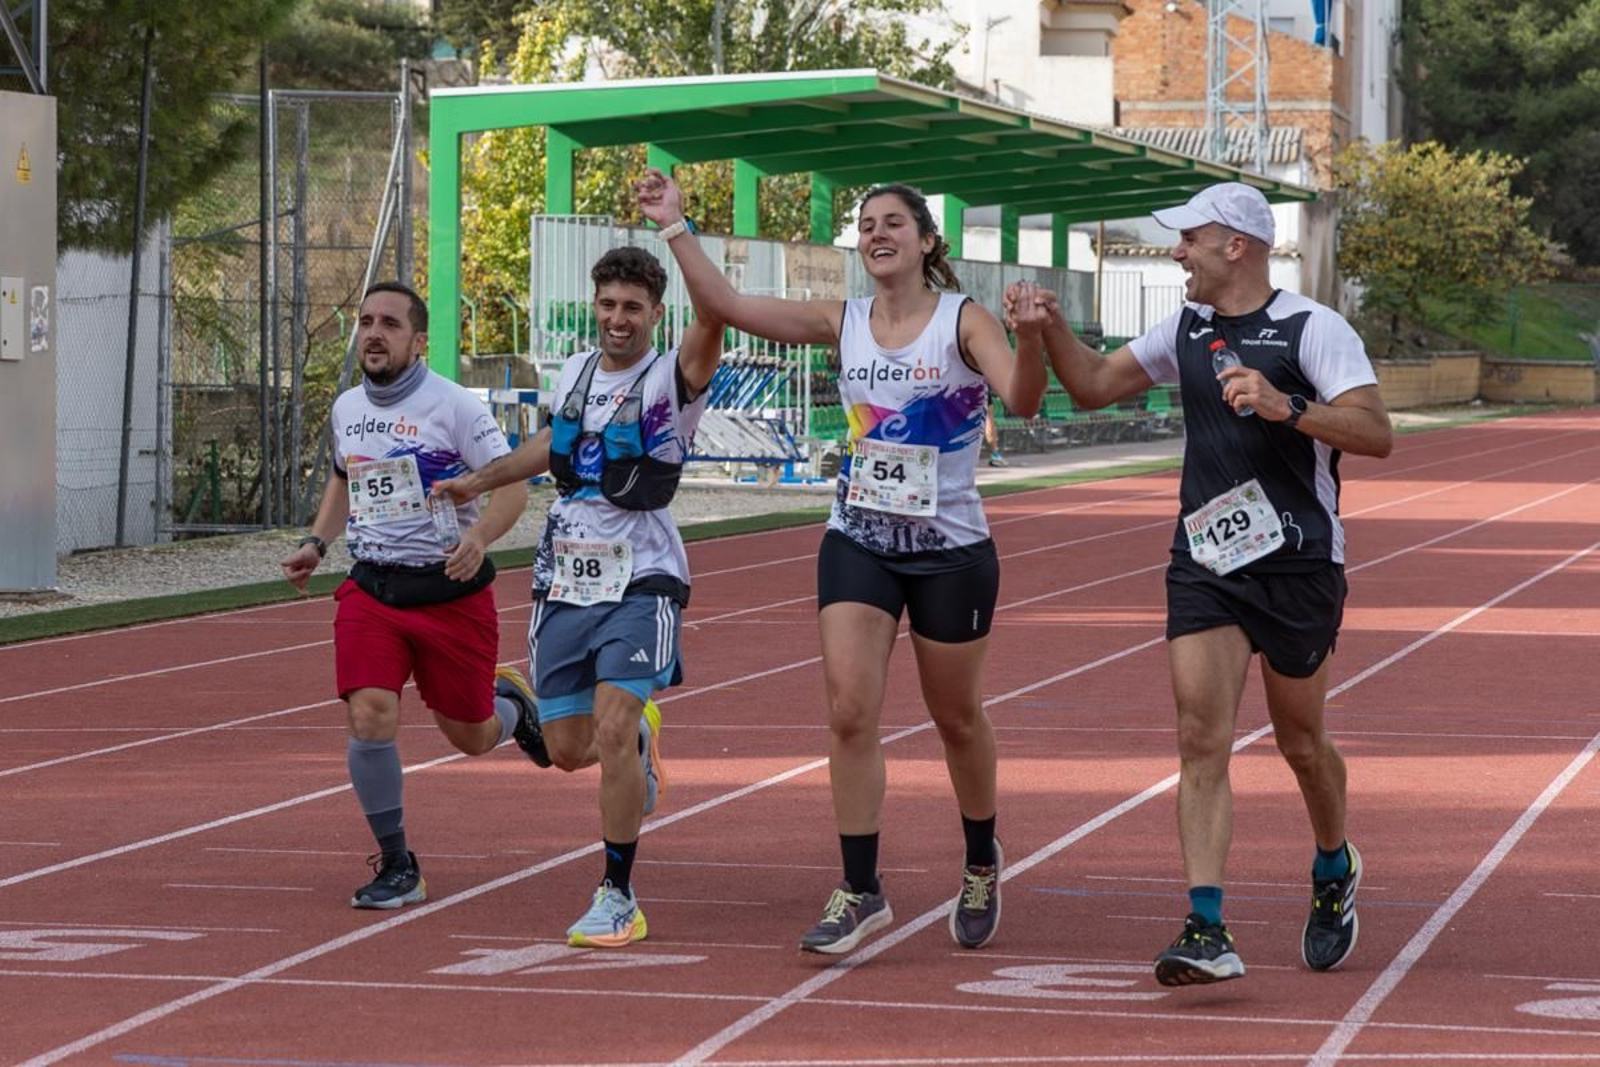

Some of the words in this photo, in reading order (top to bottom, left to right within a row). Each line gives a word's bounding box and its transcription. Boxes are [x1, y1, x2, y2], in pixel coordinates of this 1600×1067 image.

[847, 360, 940, 389] calderón
[346, 415, 418, 441] calderón
[873, 460, 906, 483] 54
[367, 476, 394, 498] 55
[1206, 509, 1251, 546] 129
[573, 557, 602, 578] 98
[428, 944, 708, 975] 4
